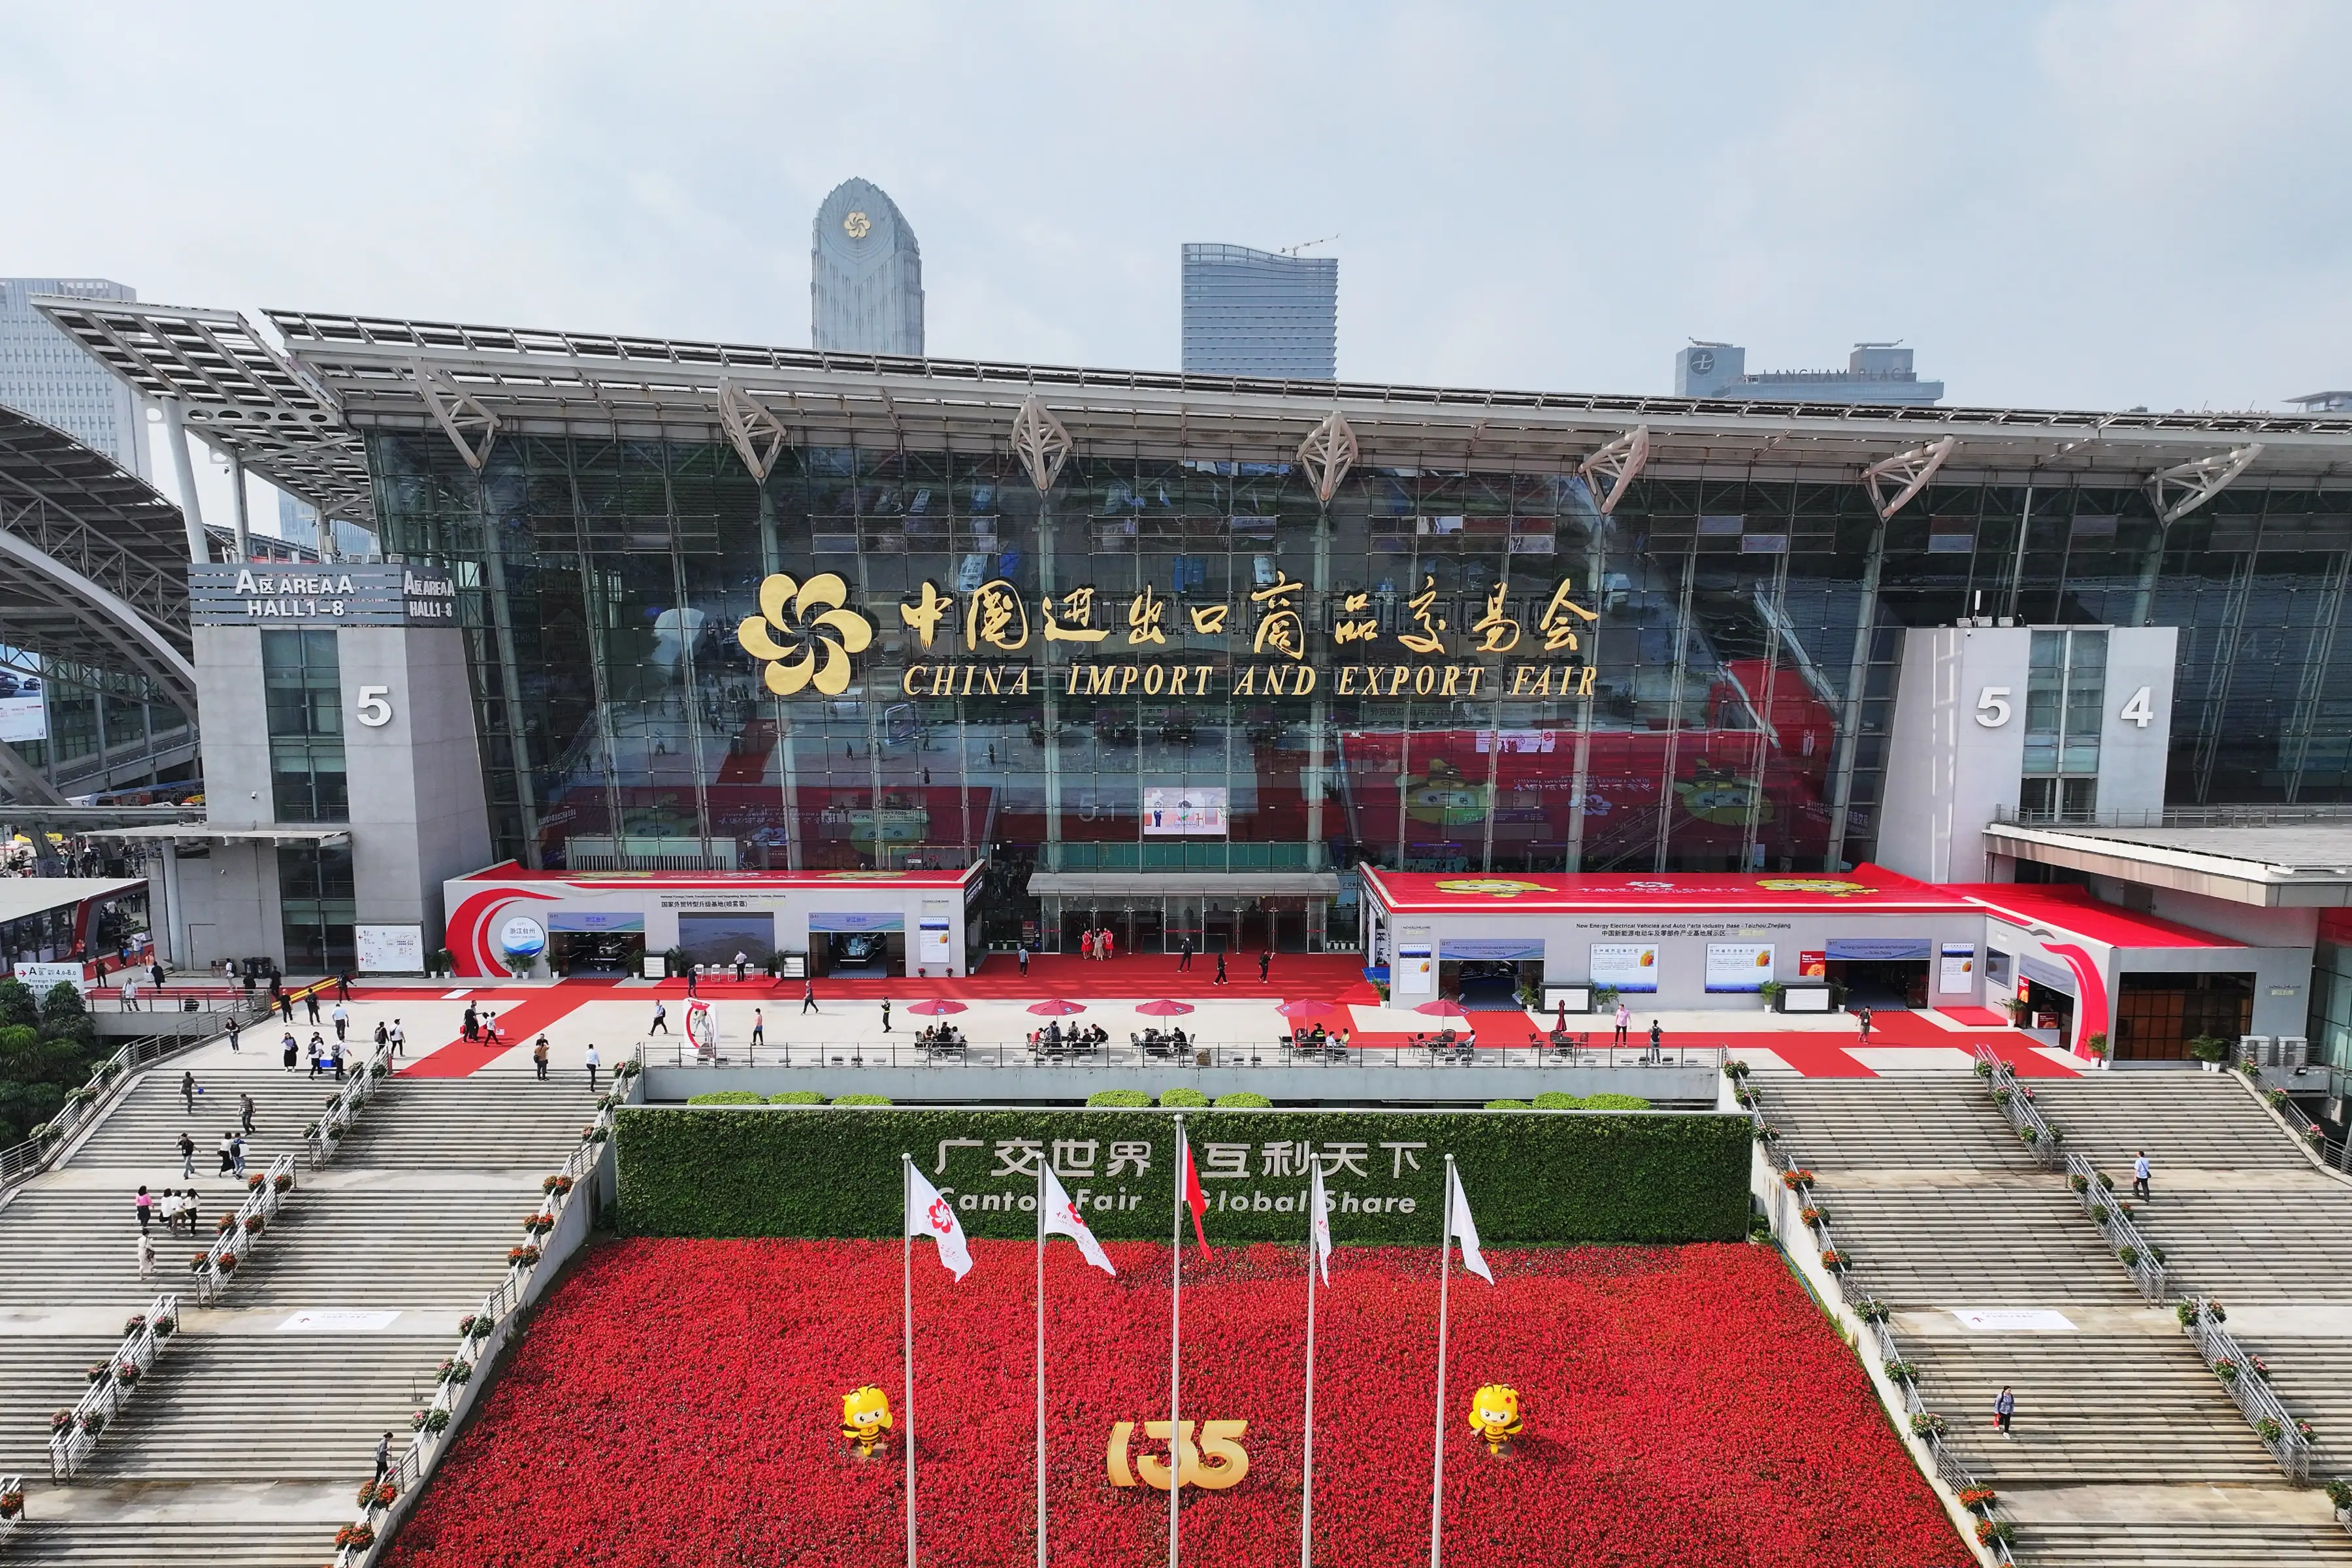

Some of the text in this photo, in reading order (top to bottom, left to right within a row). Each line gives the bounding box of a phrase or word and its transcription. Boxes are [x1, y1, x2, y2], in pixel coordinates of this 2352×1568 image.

[1763, 367, 1914, 383] LANGHAM PLACE
[904, 664, 1599, 696] CHINA IMPORT AND EXPORT FAIR
[357, 685, 393, 727] 5
[1975, 686, 2012, 728] 5
[2119, 686, 2154, 728] 4
[29, 967, 37, 975] A
[934, 1137, 1427, 1179] 广交世界 互利天下
[937, 1186, 1046, 1211] anto
[1075, 1186, 1143, 1211] Fair
[1325, 1190, 1416, 1214] Share
[1106, 1420, 1249, 1490] 135
